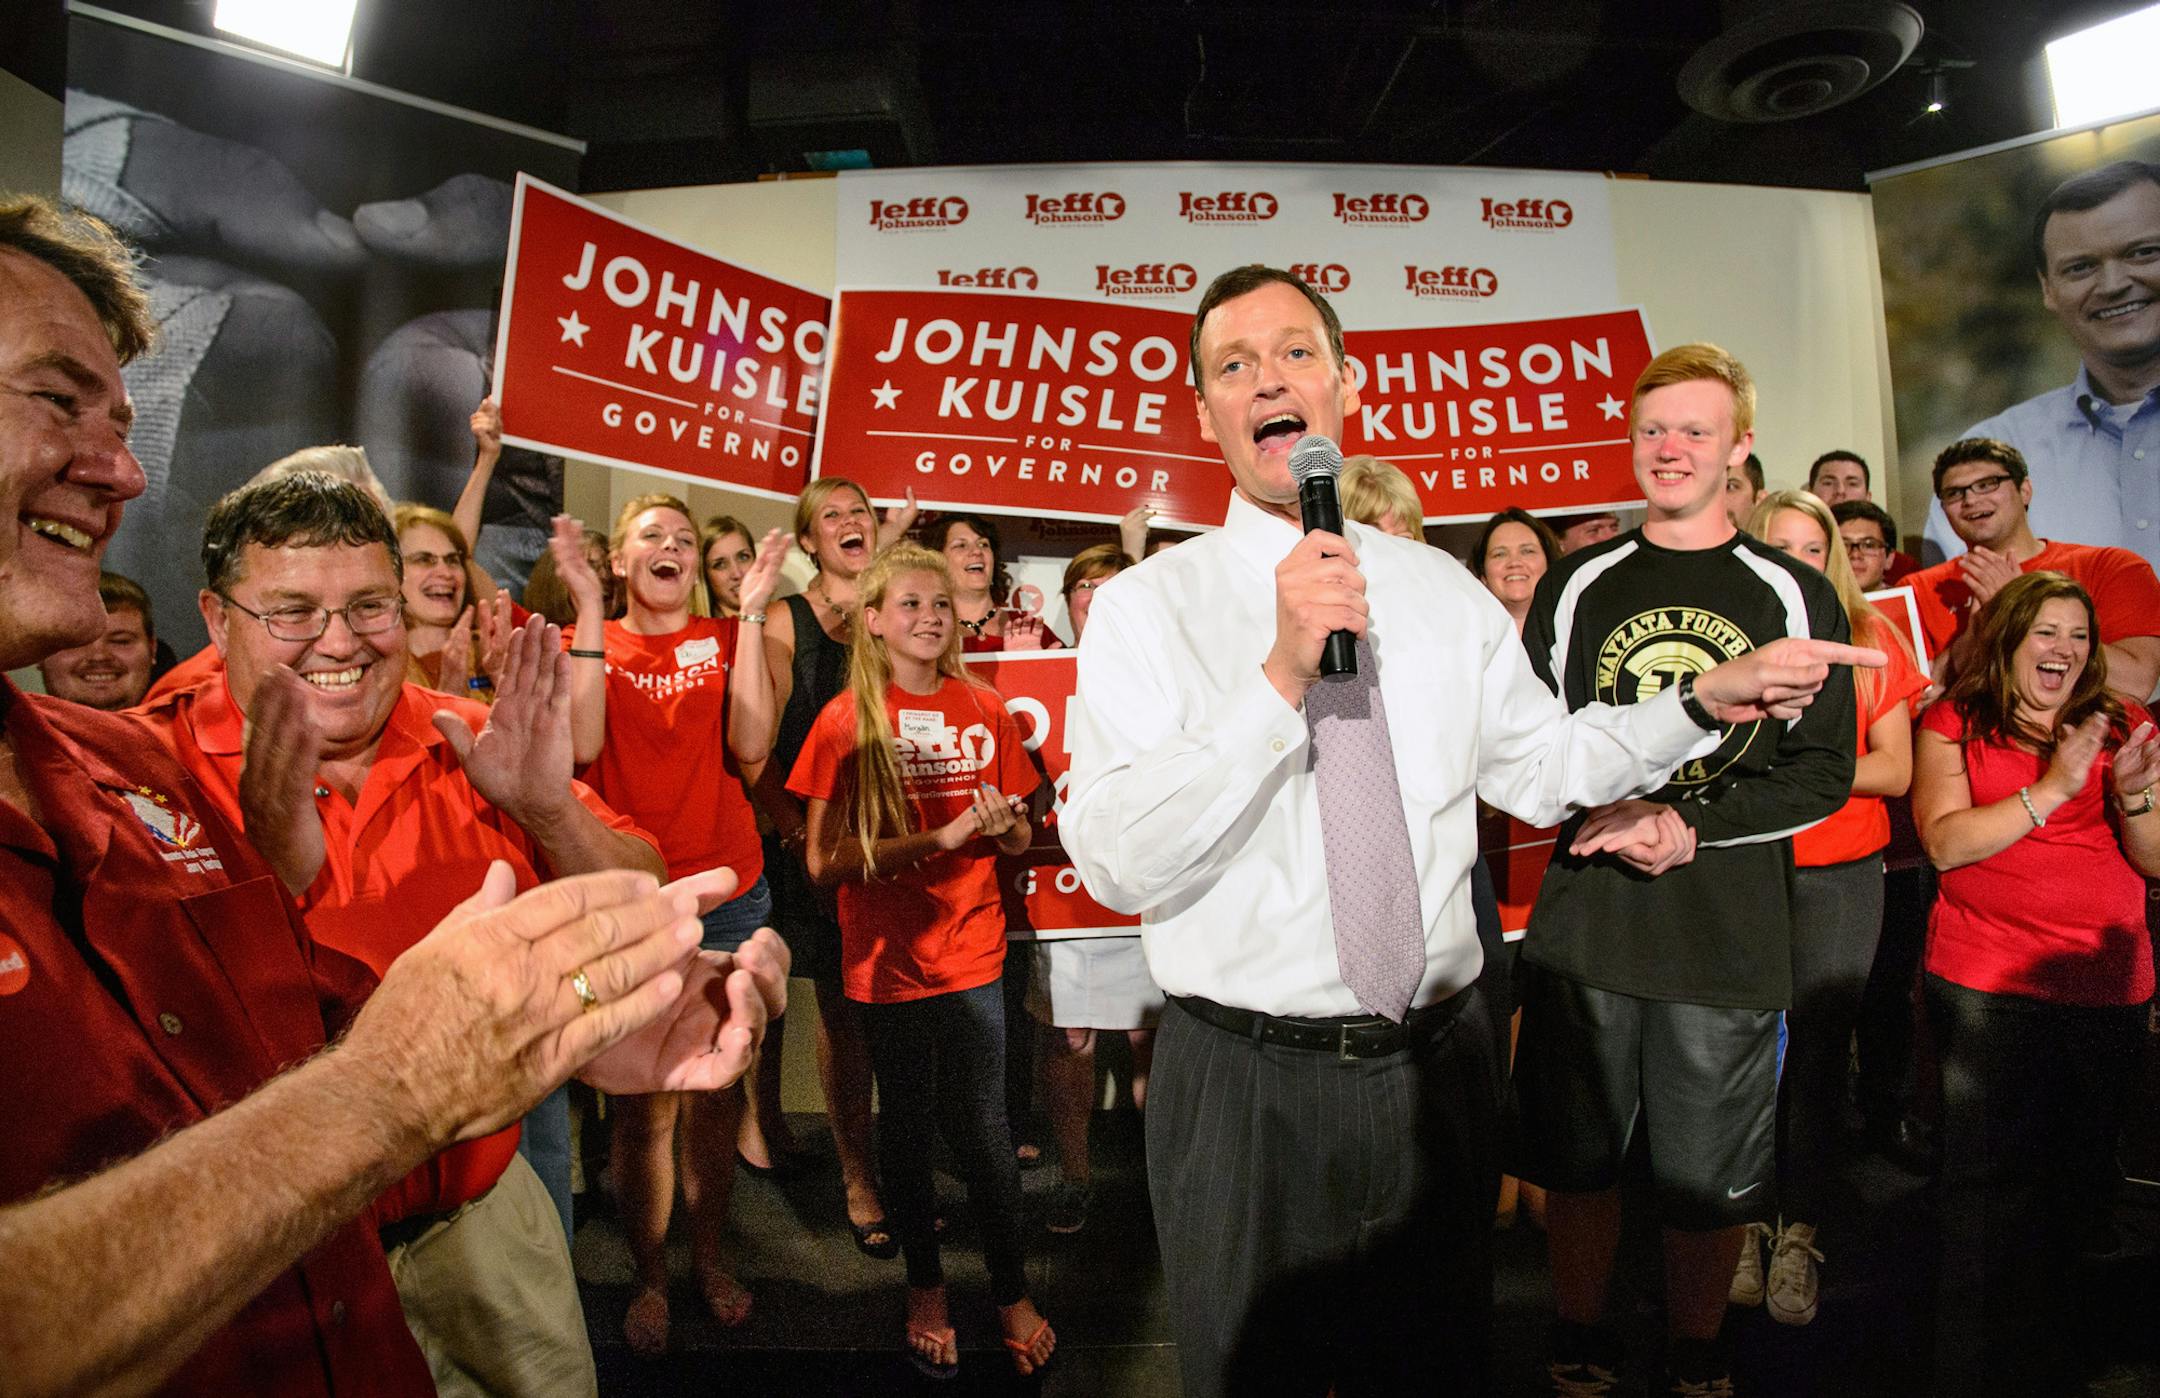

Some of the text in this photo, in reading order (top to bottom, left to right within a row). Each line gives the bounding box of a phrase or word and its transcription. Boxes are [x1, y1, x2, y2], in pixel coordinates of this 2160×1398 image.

[870, 197, 938, 224] Jeff
[1025, 193, 1095, 219] Jeff
[1179, 192, 1249, 216] Jeff
[1332, 193, 1400, 217] Jeff
[1480, 198, 1545, 221] Jeff
[878, 217, 948, 231] Johnson
[1034, 213, 1104, 225] Johnson
[1188, 211, 1260, 223] Johnson
[1342, 211, 1410, 223] Johnson
[1490, 216, 1555, 229] Johnson
[937, 268, 1007, 288] Jeff
[1096, 264, 1165, 290] Jeff
[1404, 266, 1470, 290] Jeff
[562, 241, 828, 364] JOHNSO
[1105, 284, 1176, 297] Johnson
[1414, 285, 1480, 298] Johnson
[875, 318, 1195, 386] JOHNSO
[624, 322, 823, 416] KUISLE
[703, 402, 745, 425] FOR
[938, 376, 1167, 435] KUISLE
[1361, 392, 1568, 442] KUISLE
[602, 403, 800, 467] GOVERNO
[1025, 435, 1072, 451] FOR
[1451, 446, 1494, 461] FOR
[915, 451, 1170, 492] GOVERNOR
[1420, 459, 1590, 491] VERNOR
[1598, 611, 1748, 690] WAYZATA FOOTB
[650, 677, 705, 701] ERNOR
[894, 726, 961, 761] eff
